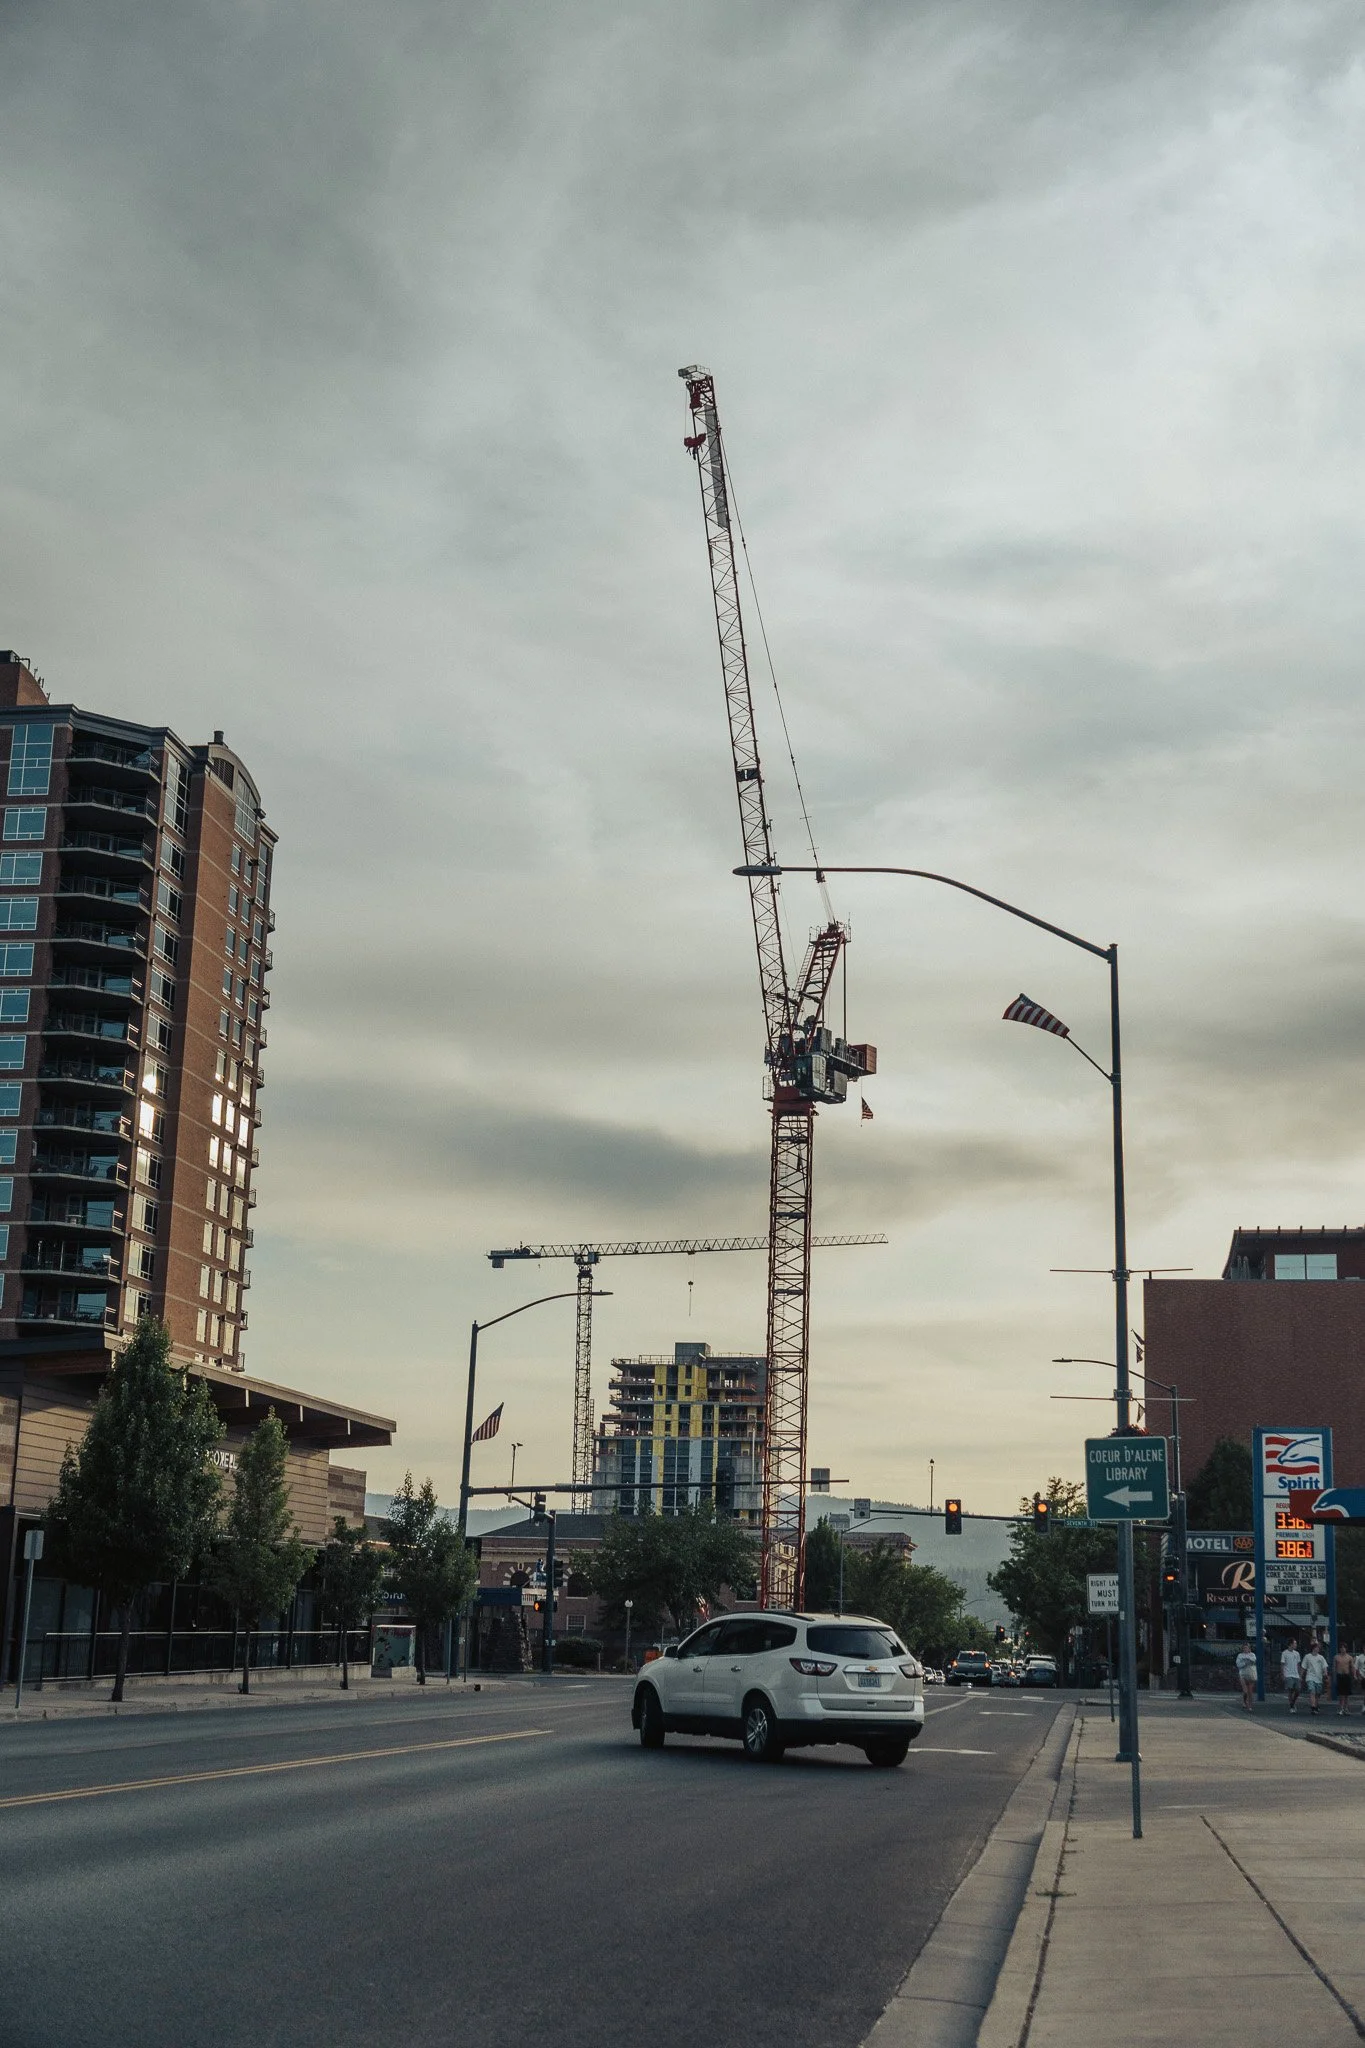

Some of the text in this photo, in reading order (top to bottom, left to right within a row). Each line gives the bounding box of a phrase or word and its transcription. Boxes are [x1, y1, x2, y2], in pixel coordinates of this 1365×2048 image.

[1089, 1449, 1164, 1463] COEUR D'ALENE
[1106, 1467, 1148, 1481] LIBRARY
[1278, 1476, 1320, 1491] Spirit
[1187, 1538, 1229, 1550] MOTEL
[1206, 1593, 1237, 1603] RESORT
[1241, 1593, 1255, 1603] CIT
